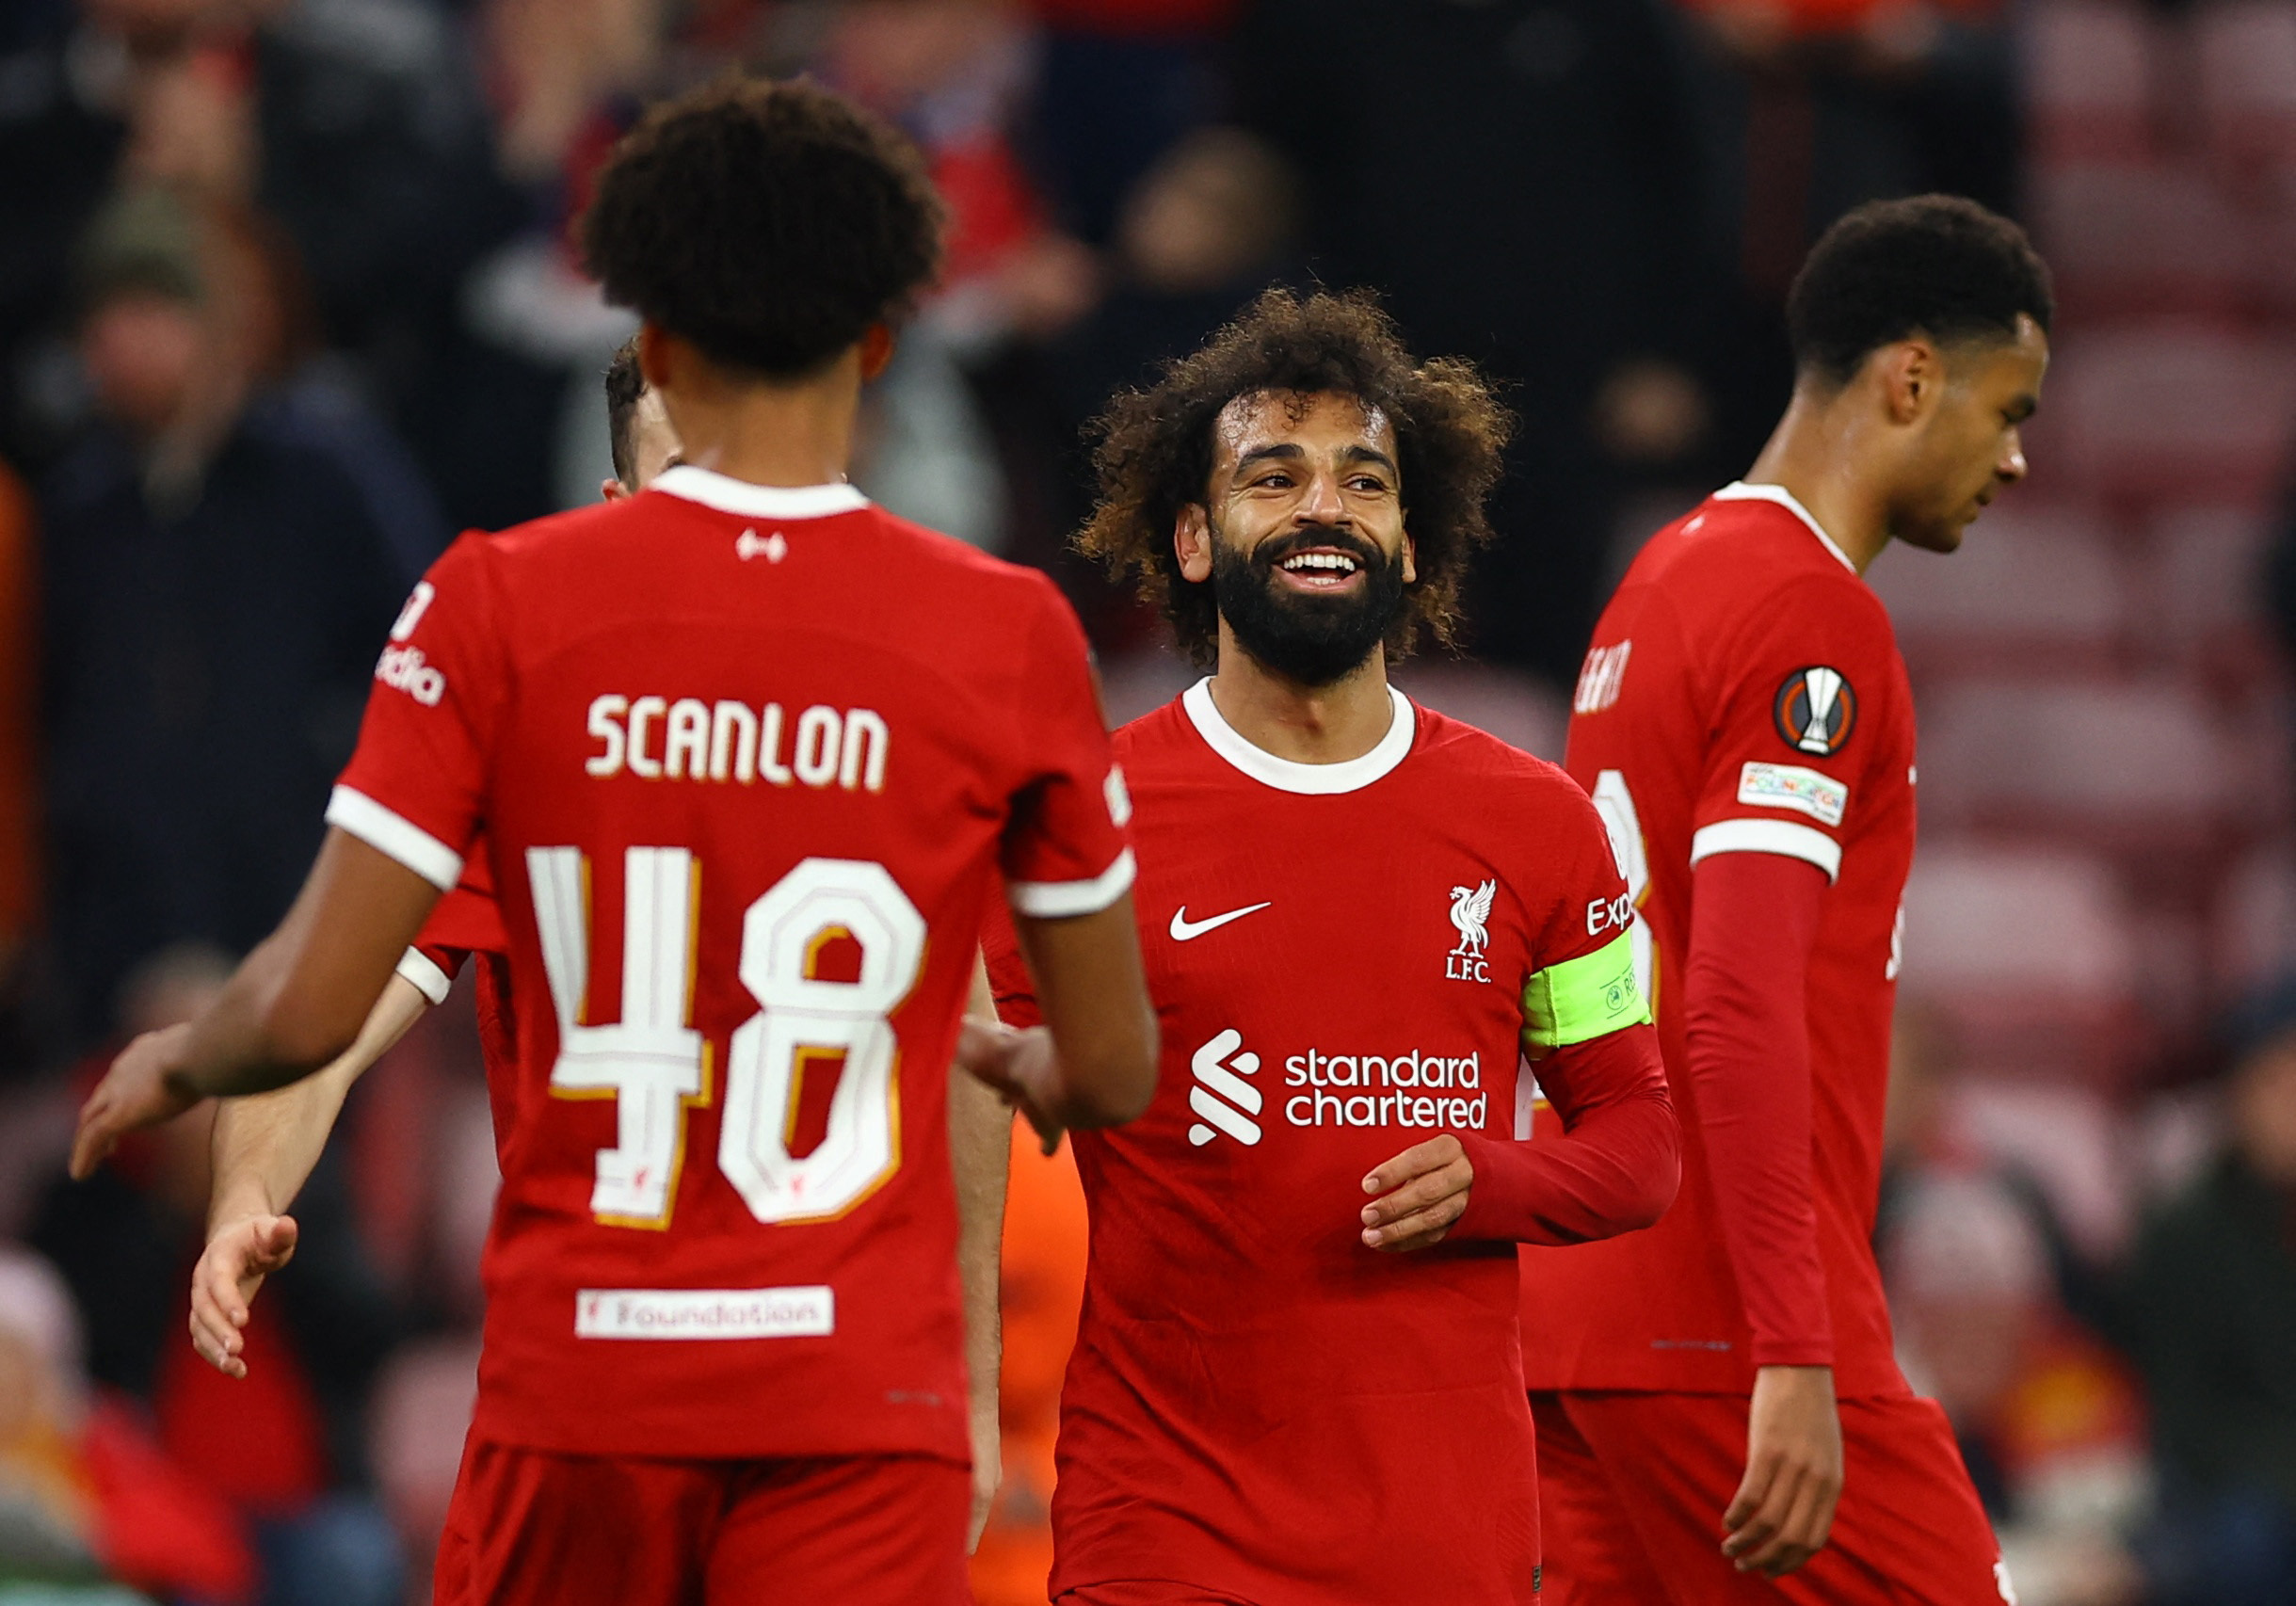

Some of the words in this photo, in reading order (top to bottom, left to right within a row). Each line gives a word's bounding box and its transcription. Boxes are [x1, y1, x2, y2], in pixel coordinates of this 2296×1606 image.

[585, 693, 890, 794] SCANLON
[1587, 892, 1633, 936] Exp
[524, 845, 930, 1231] 48
[1285, 1048, 1479, 1088] standard
[1285, 1088, 1486, 1130] chartered
